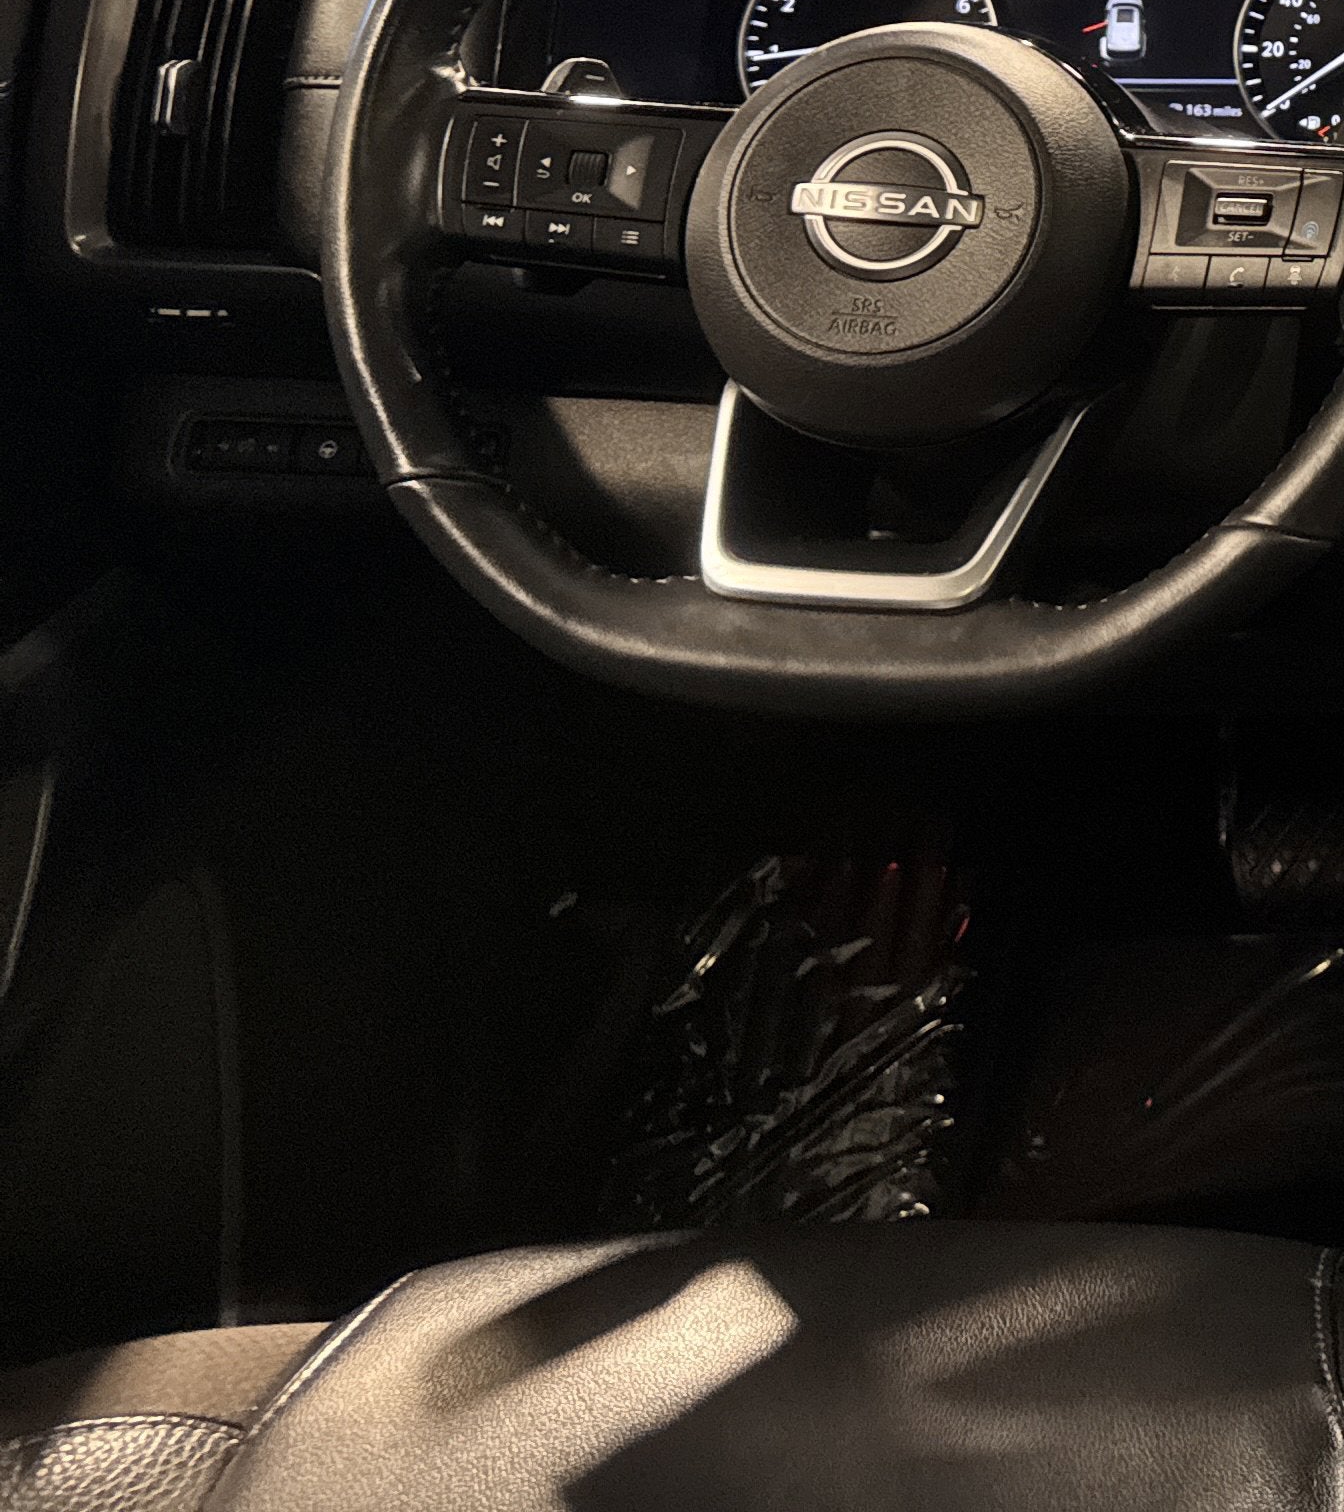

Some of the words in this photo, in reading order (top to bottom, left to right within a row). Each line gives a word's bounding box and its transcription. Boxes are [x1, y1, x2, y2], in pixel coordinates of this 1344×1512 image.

[1261, 41, 1285, 58] 20
[1297, 59, 1312, 70] 20
[1185, 104, 1212, 117] 163
[572, 192, 592, 204] OK
[799, 188, 978, 222] NISSAN
[1219, 202, 1264, 215] CANCEL
[851, 298, 883, 313] SRS
[828, 319, 897, 335] AIRBAG
